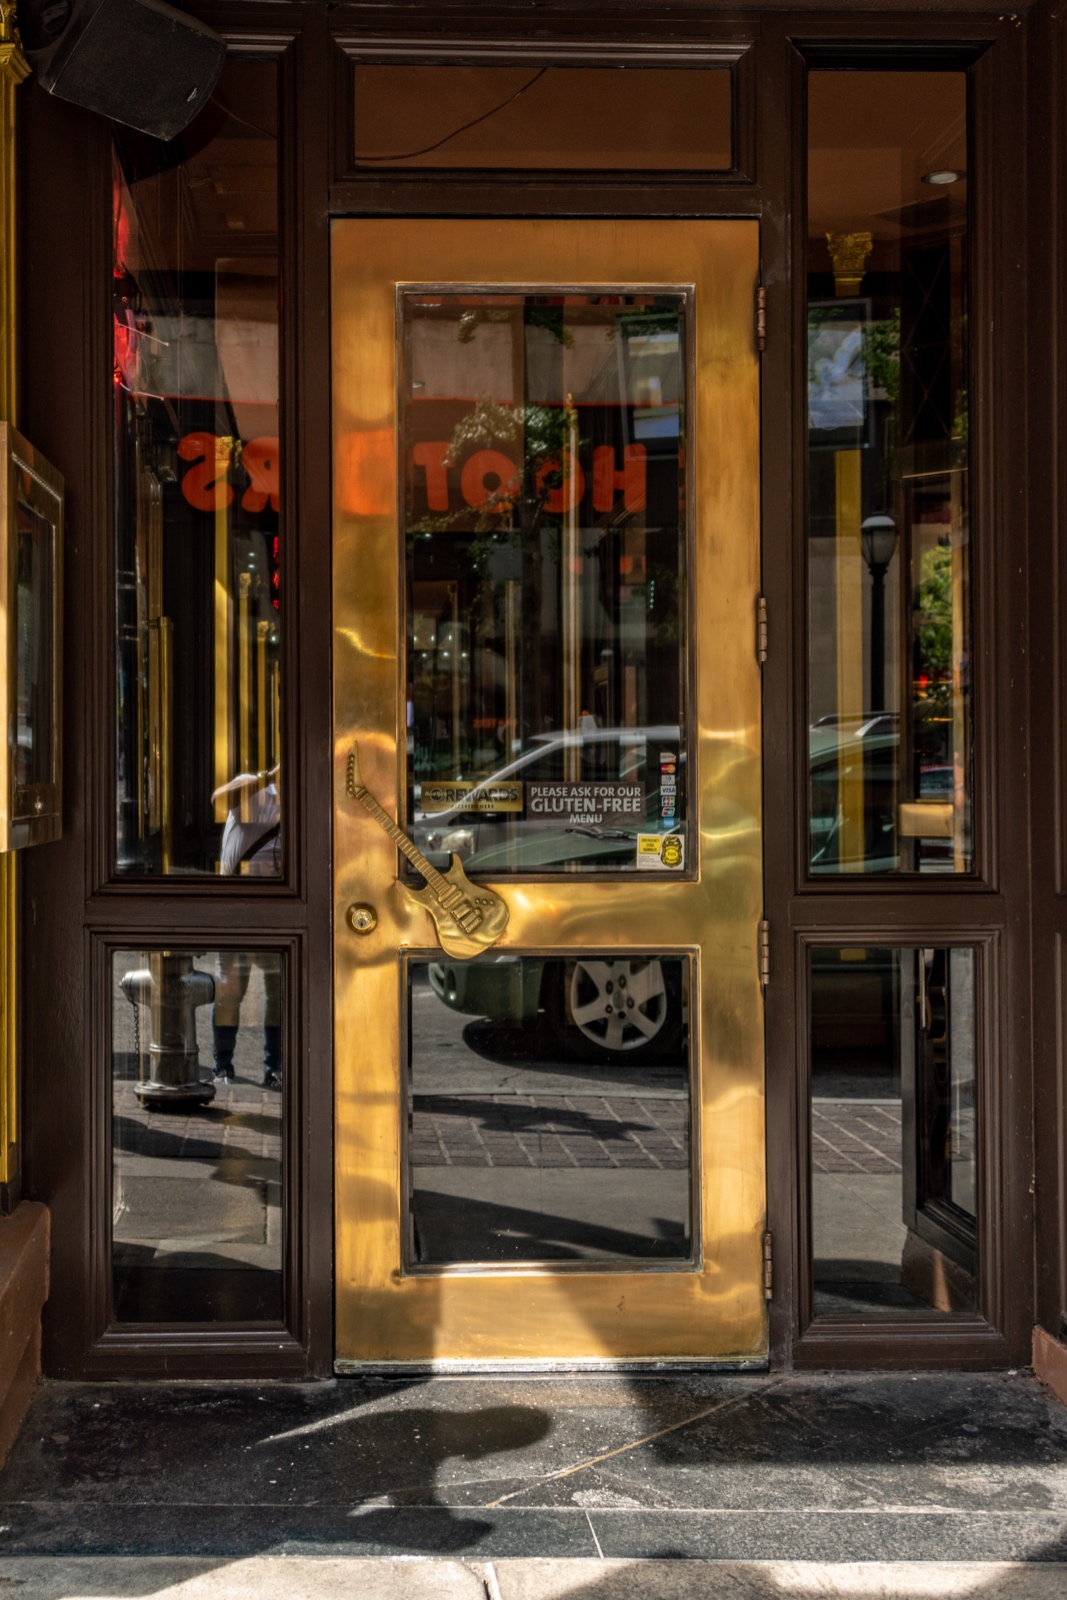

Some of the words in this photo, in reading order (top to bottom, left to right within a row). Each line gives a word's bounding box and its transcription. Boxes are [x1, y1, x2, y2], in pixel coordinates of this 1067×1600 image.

[446, 788, 519, 802] REWARDS
[531, 787, 568, 797] PLEASE
[570, 787, 591, 797] ASK
[594, 787, 615, 797] FOR
[617, 787, 641, 797] OUR
[531, 798, 641, 812] GLUTEN-FREE
[569, 814, 603, 824] MENU
